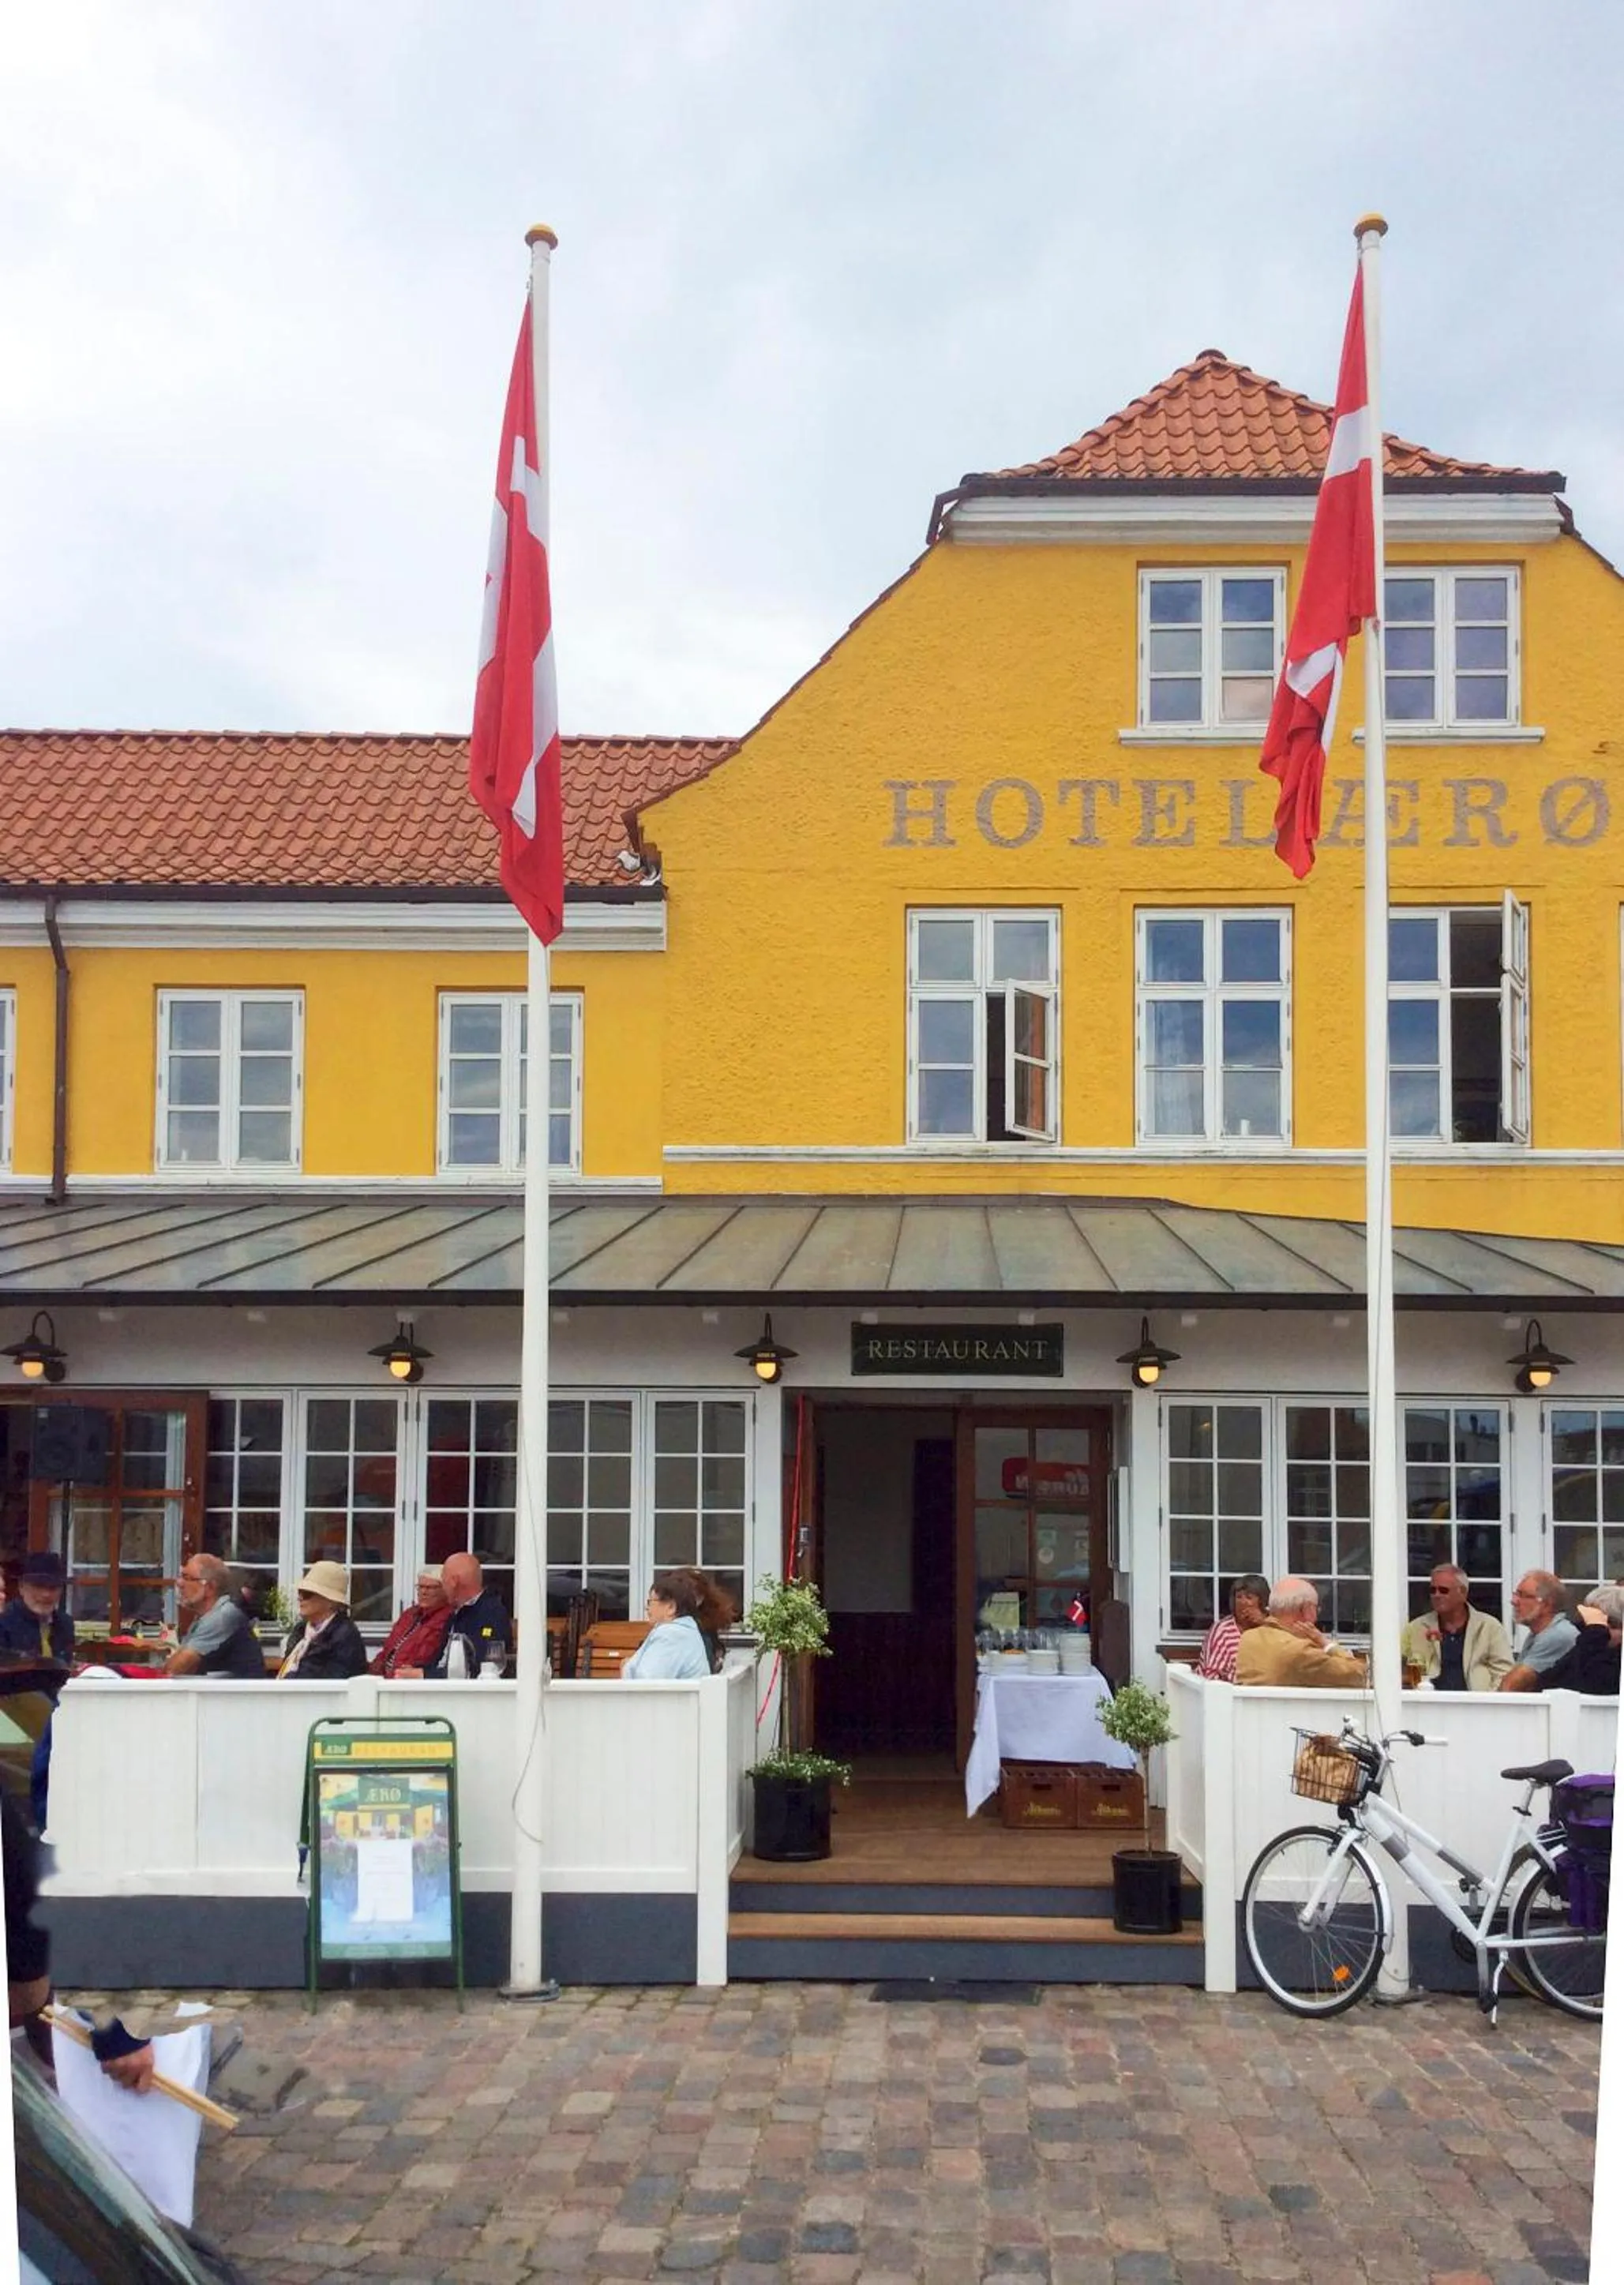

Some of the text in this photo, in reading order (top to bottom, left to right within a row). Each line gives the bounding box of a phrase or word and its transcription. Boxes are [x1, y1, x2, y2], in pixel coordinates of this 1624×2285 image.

[883, 776, 1610, 847] HOTEL ÆRØ
[869, 1340, 1048, 1360] RESTAURANT
